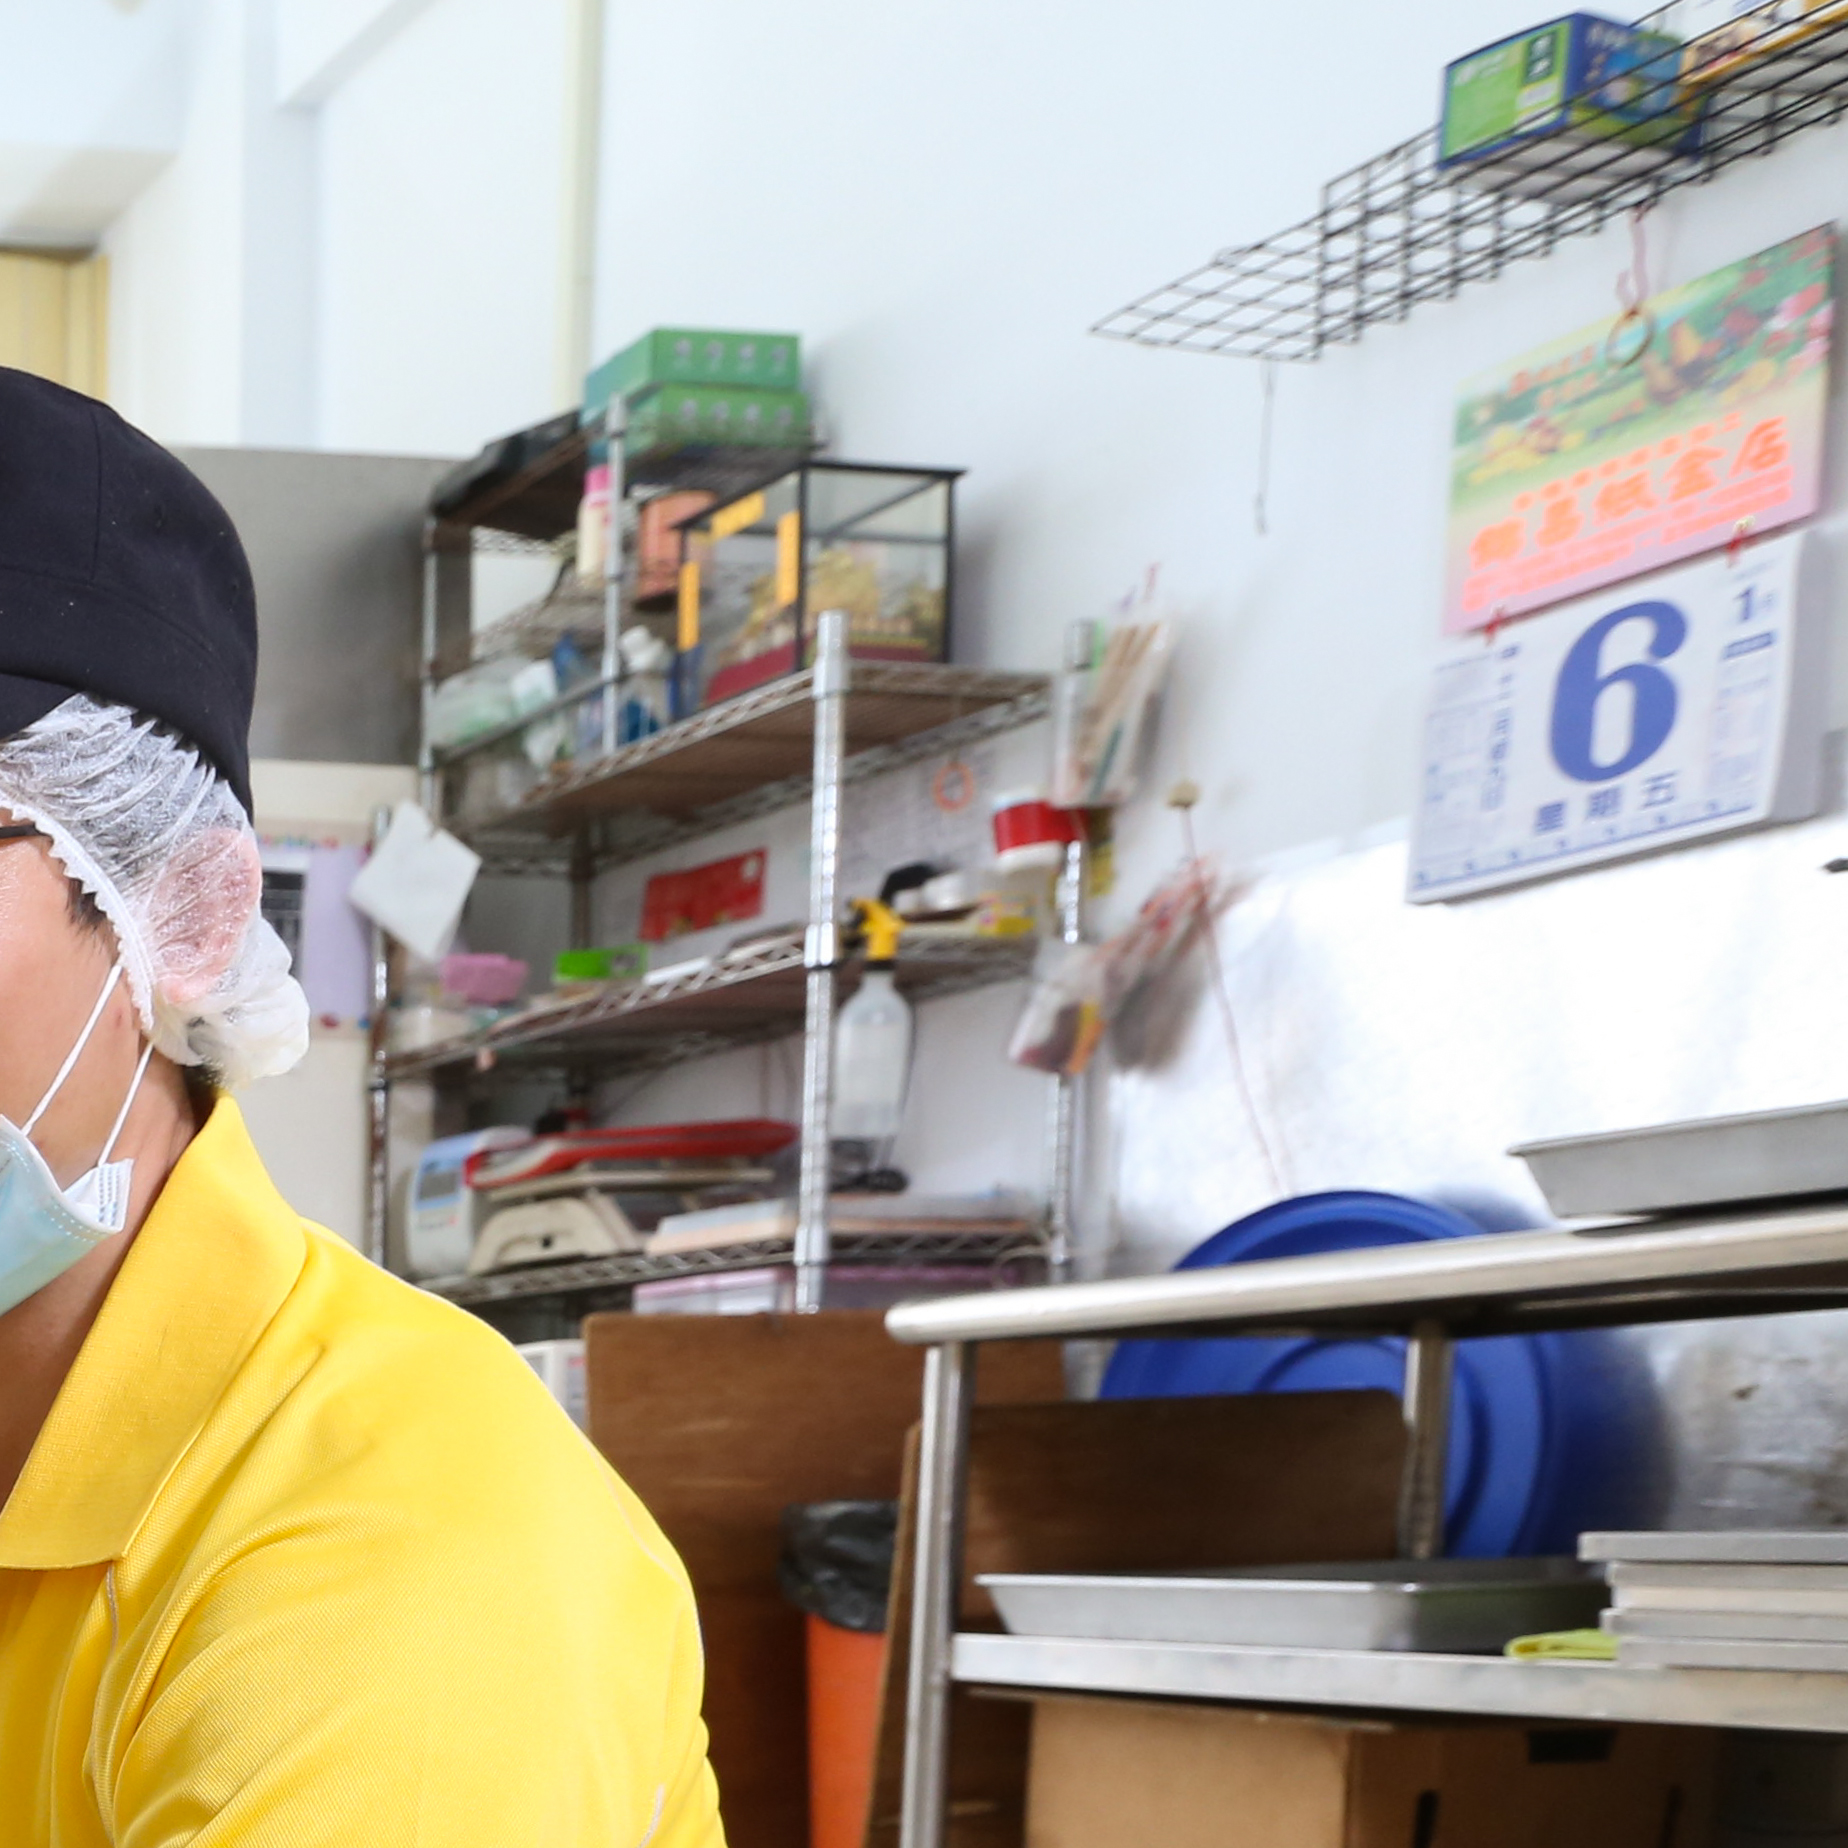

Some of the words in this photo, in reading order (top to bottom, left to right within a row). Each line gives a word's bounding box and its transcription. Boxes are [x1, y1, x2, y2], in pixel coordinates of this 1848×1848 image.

[1550, 599, 1688, 784] 6
[1534, 770, 1680, 837] 星期五
